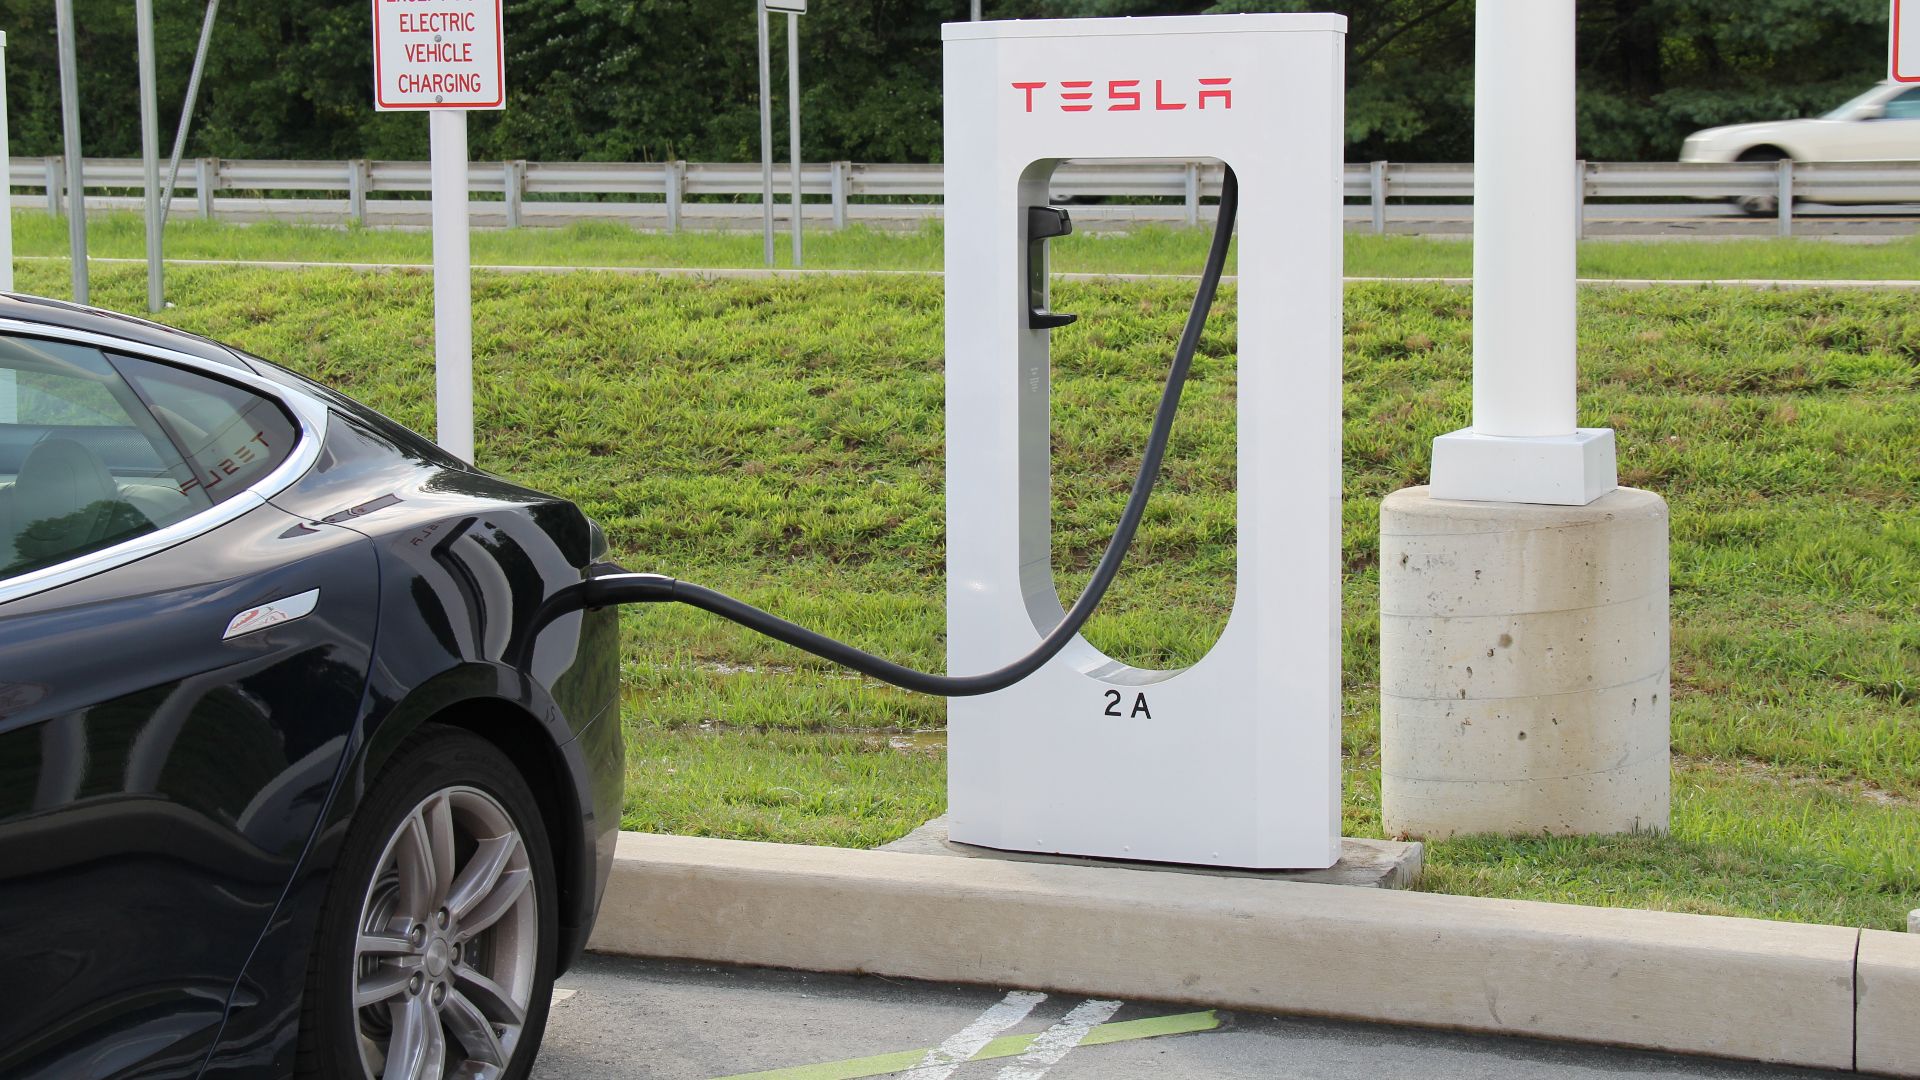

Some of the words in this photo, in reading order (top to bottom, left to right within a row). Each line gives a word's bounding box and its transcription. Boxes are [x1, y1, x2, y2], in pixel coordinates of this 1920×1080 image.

[399, 12, 475, 32] ELECTRIC
[404, 43, 473, 62] VEHICLE
[398, 73, 482, 93] CHARGING
[1011, 78, 1232, 112] TESLA
